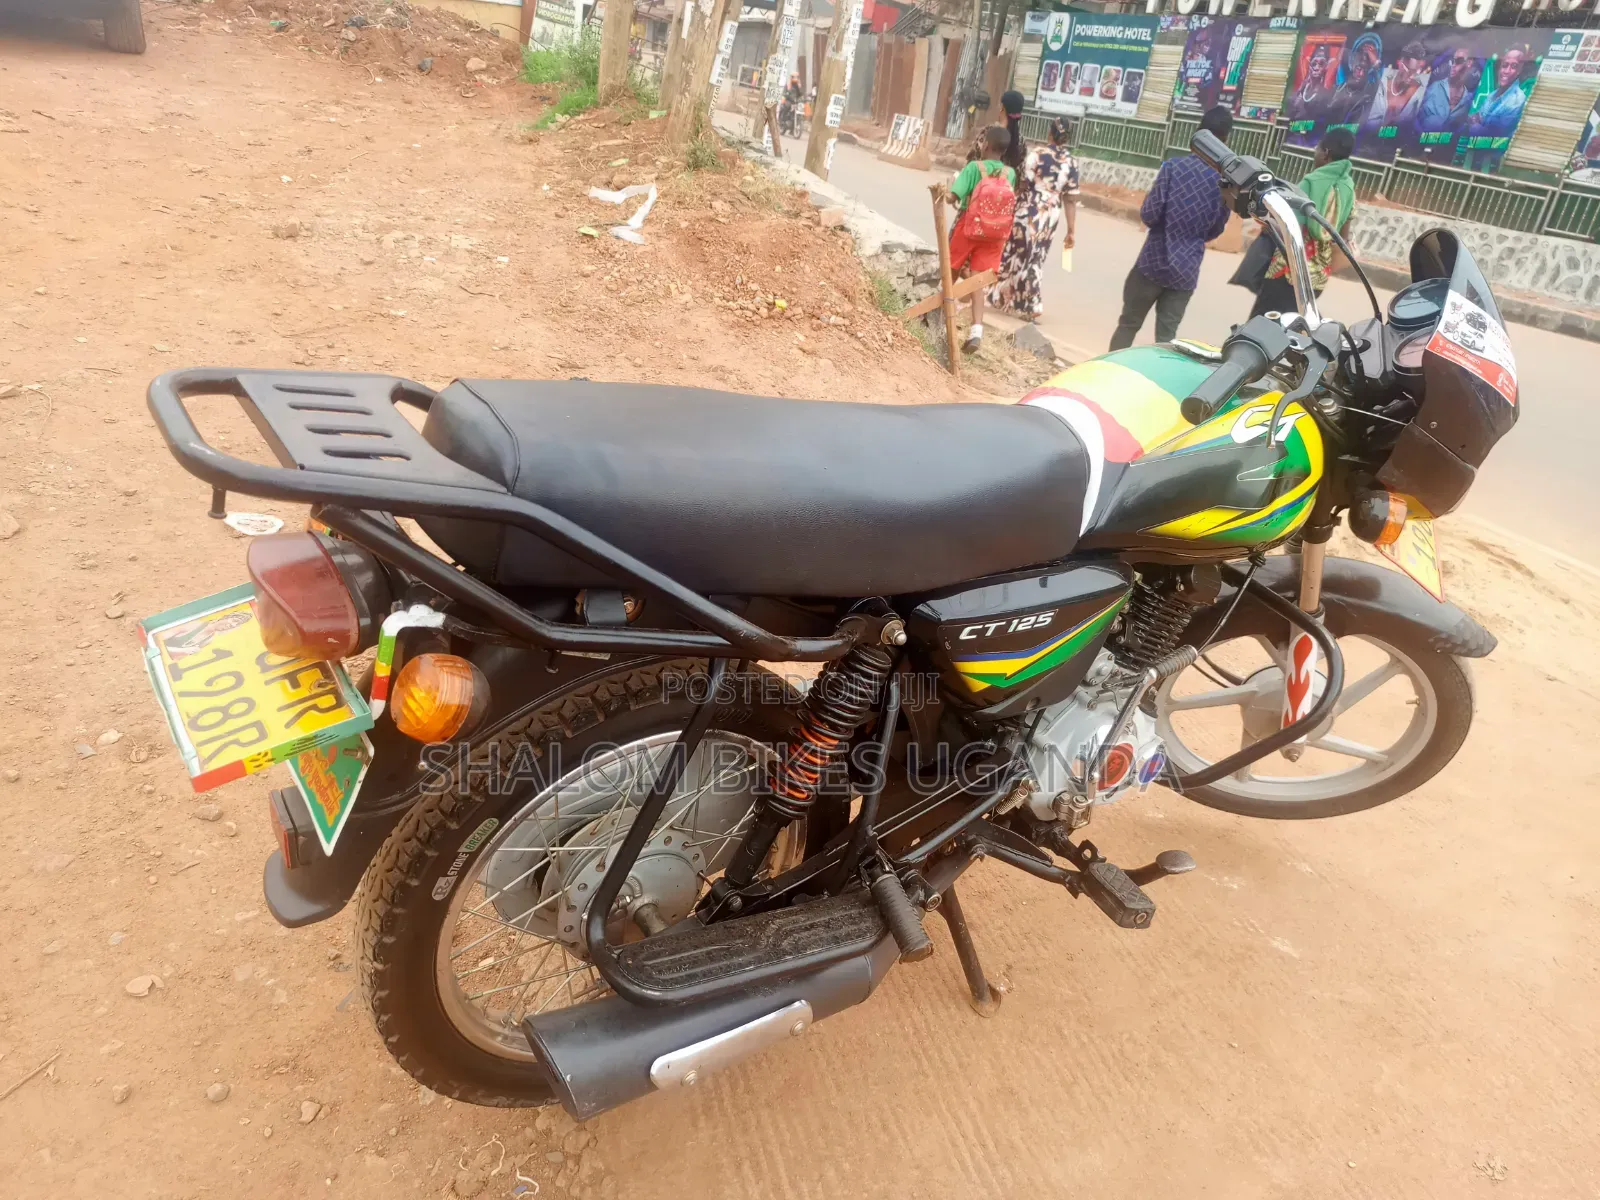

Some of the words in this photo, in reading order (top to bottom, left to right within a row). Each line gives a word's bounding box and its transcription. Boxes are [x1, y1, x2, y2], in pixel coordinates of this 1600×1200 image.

[1074, 24, 1123, 38] POWERKING
[1124, 27, 1152, 41] HOTEL
[959, 622, 1006, 641] CT
[1007, 612, 1055, 635] 125
[168, 648, 268, 771] 198R
[447, 852, 470, 876] STONE
[465, 819, 498, 850] BREAKER
